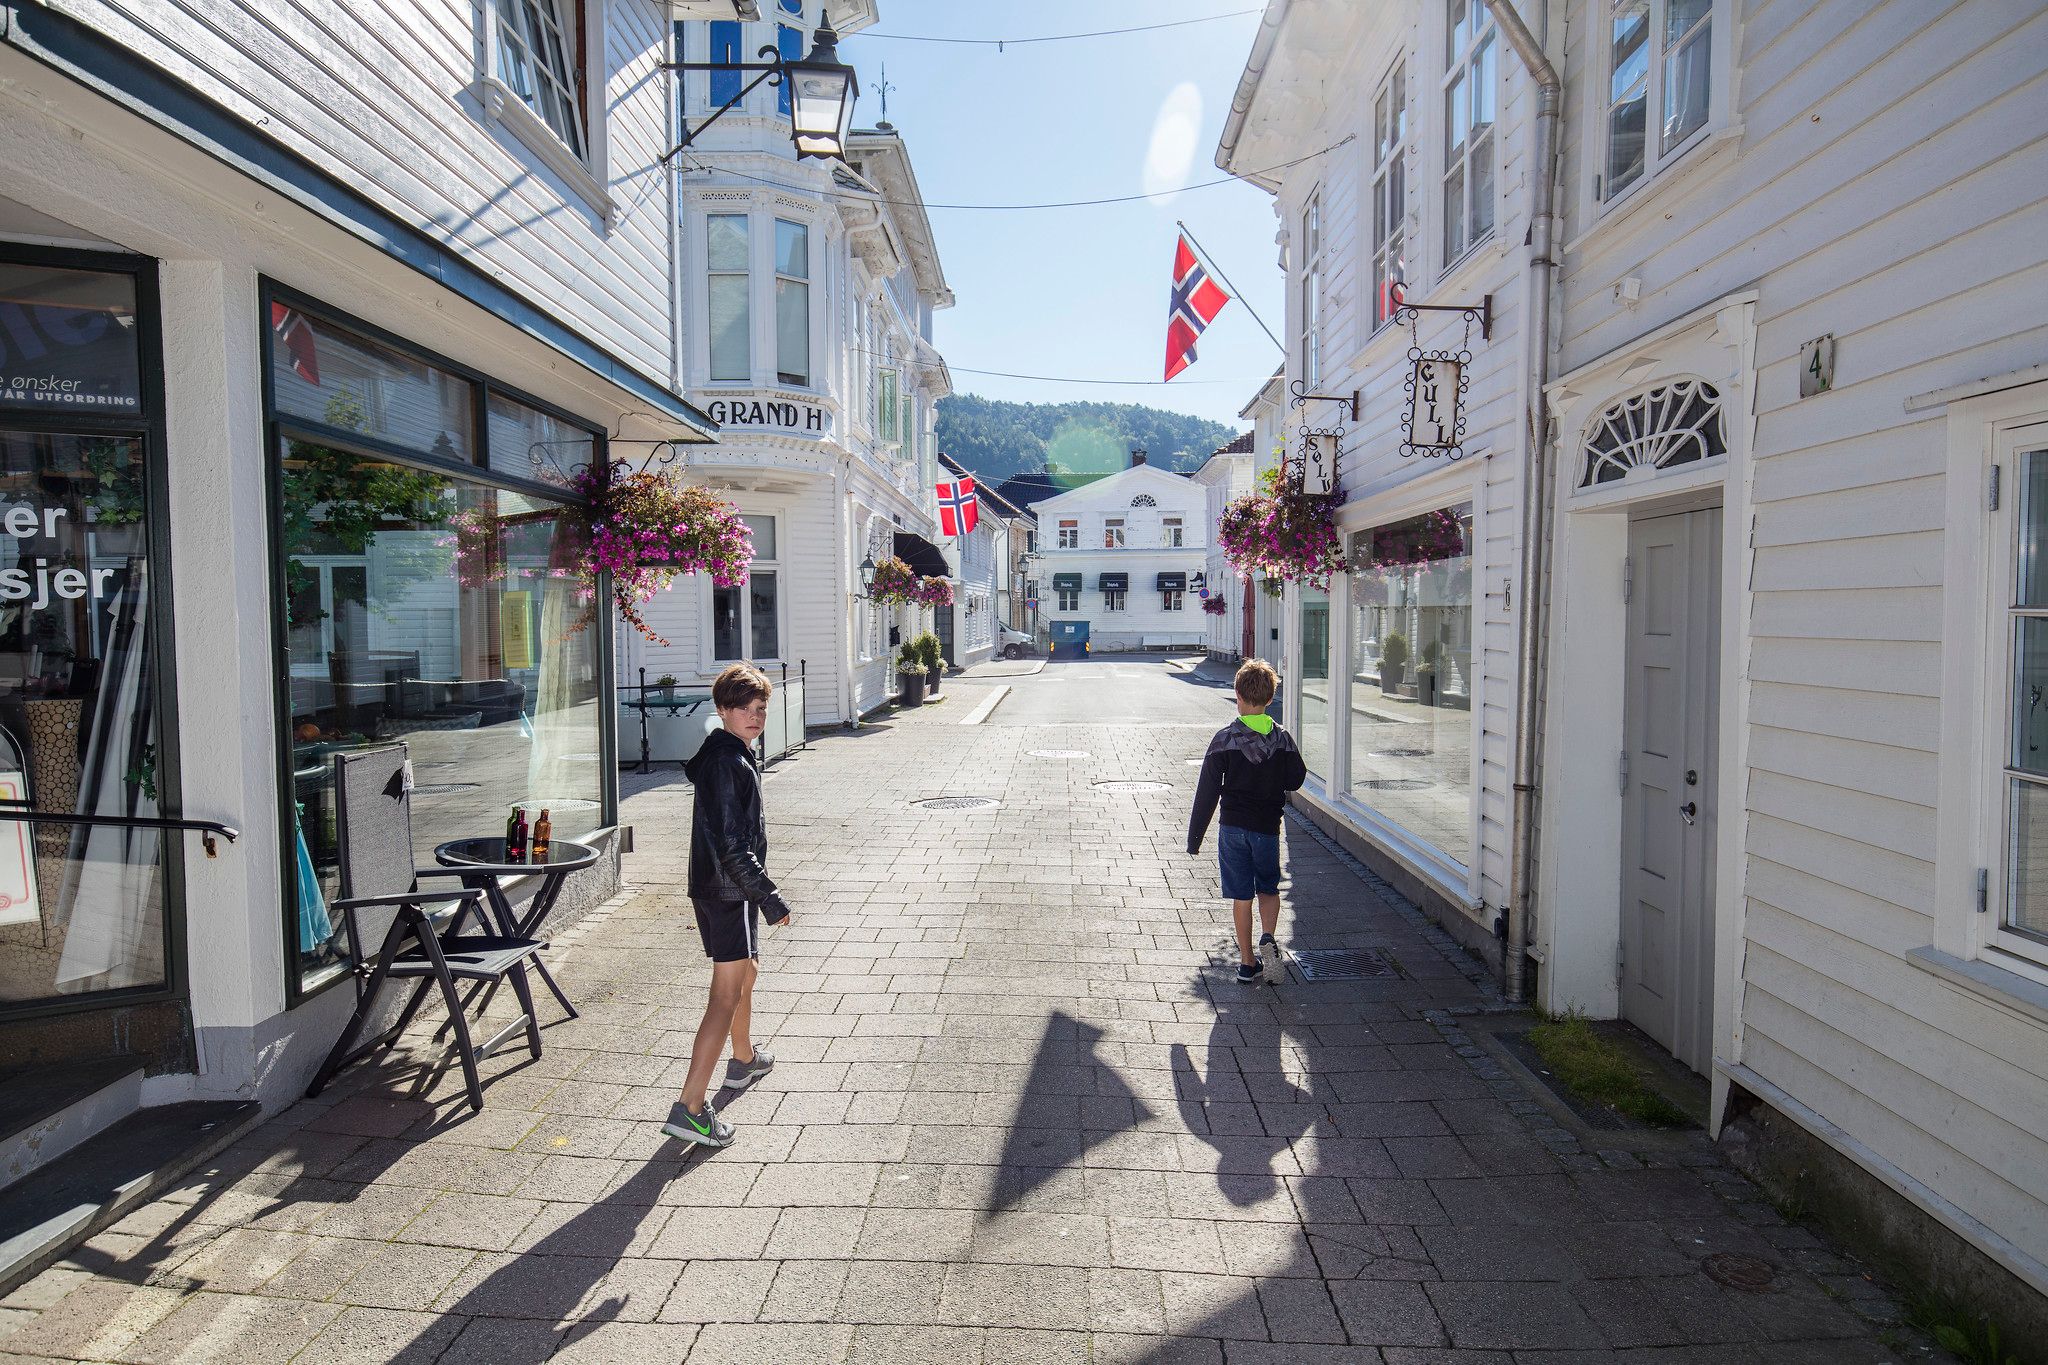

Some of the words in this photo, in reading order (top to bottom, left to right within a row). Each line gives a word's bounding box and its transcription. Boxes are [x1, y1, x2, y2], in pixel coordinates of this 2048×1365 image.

[1809, 347, 1822, 379] 4
[0, 388, 26, 400] ÅR
[34, 392, 136, 406] UTFORDRING
[11, 375, 82, 392] ønsker
[707, 400, 799, 428] GRAND
[1420, 363, 1451, 444] GULL
[4, 506, 68, 538] er
[0, 558, 115, 610] sjer
[1505, 584, 1511, 607] 6
